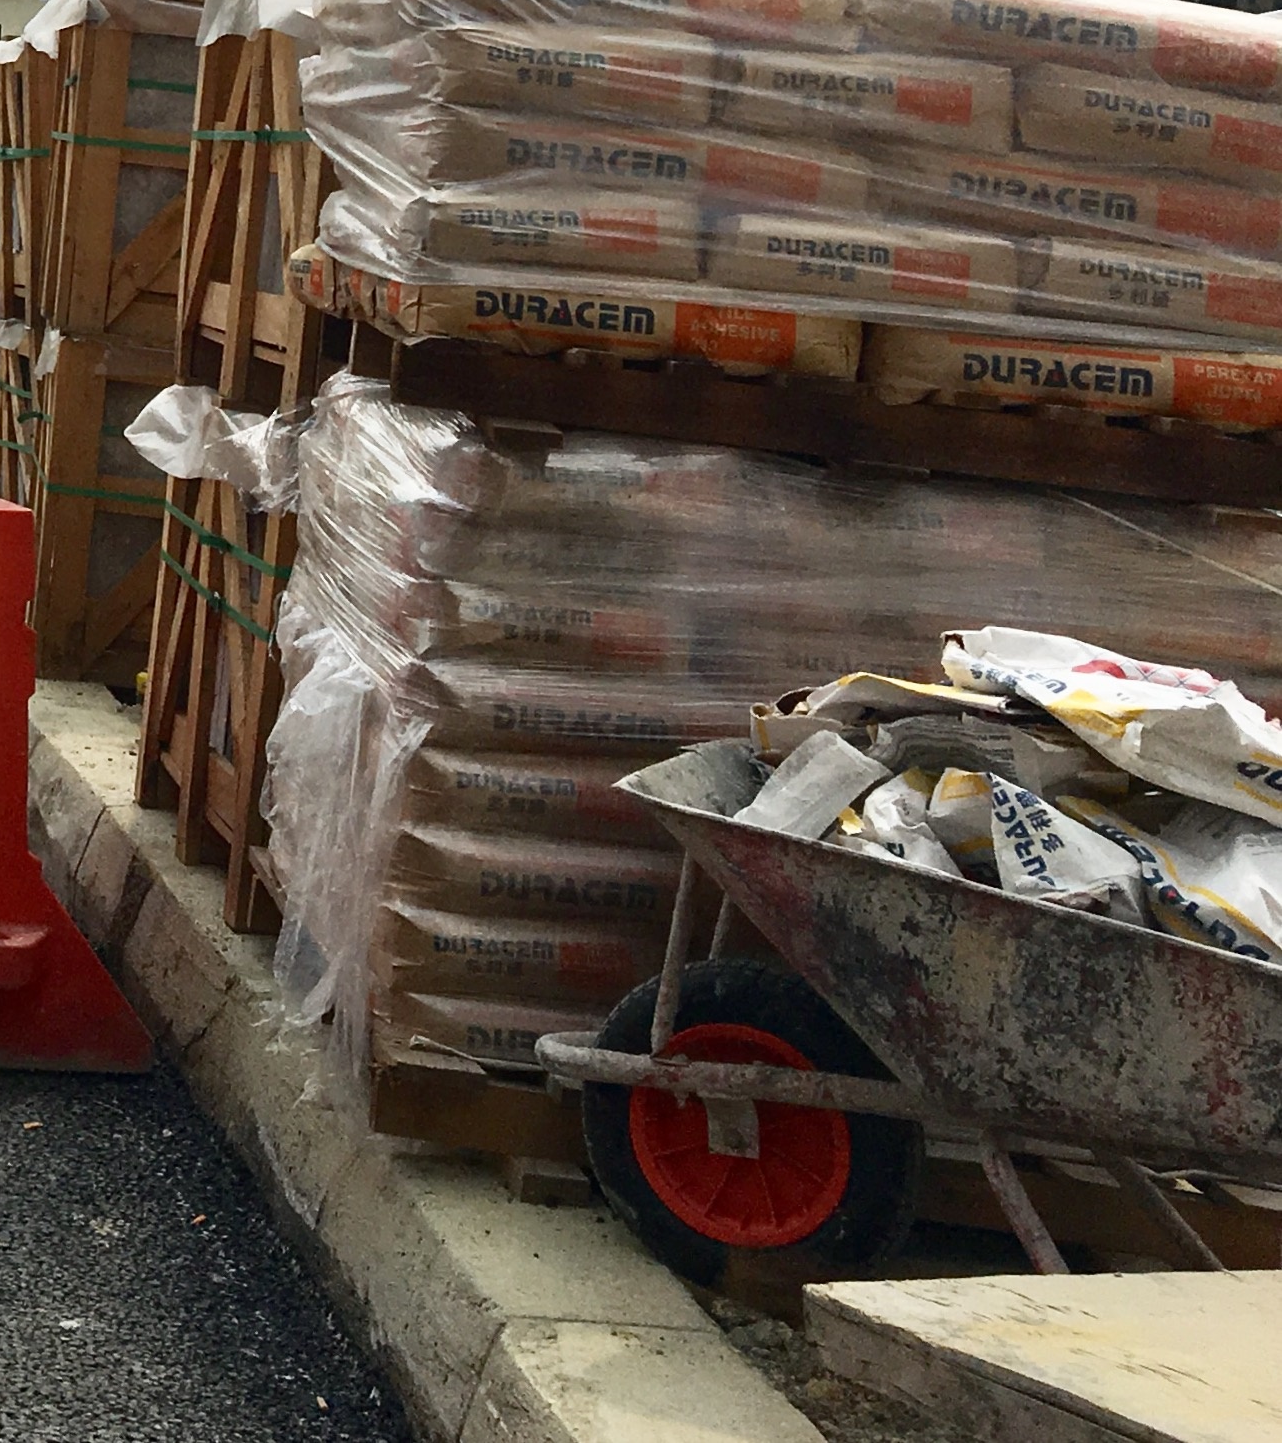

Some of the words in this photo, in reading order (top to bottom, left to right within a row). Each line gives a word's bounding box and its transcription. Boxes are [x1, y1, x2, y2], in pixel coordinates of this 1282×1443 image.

[487, 44, 607, 71] DURACEM
[771, 71, 894, 95] DURACEM
[1085, 89, 1212, 128] DURACEM
[505, 137, 688, 181] DURACEM
[767, 236, 891, 265] DURACEM
[1080, 258, 1205, 290] DURACEM
[474, 290, 655, 335] DURACEM
[963, 352, 1154, 397] DURACEM
